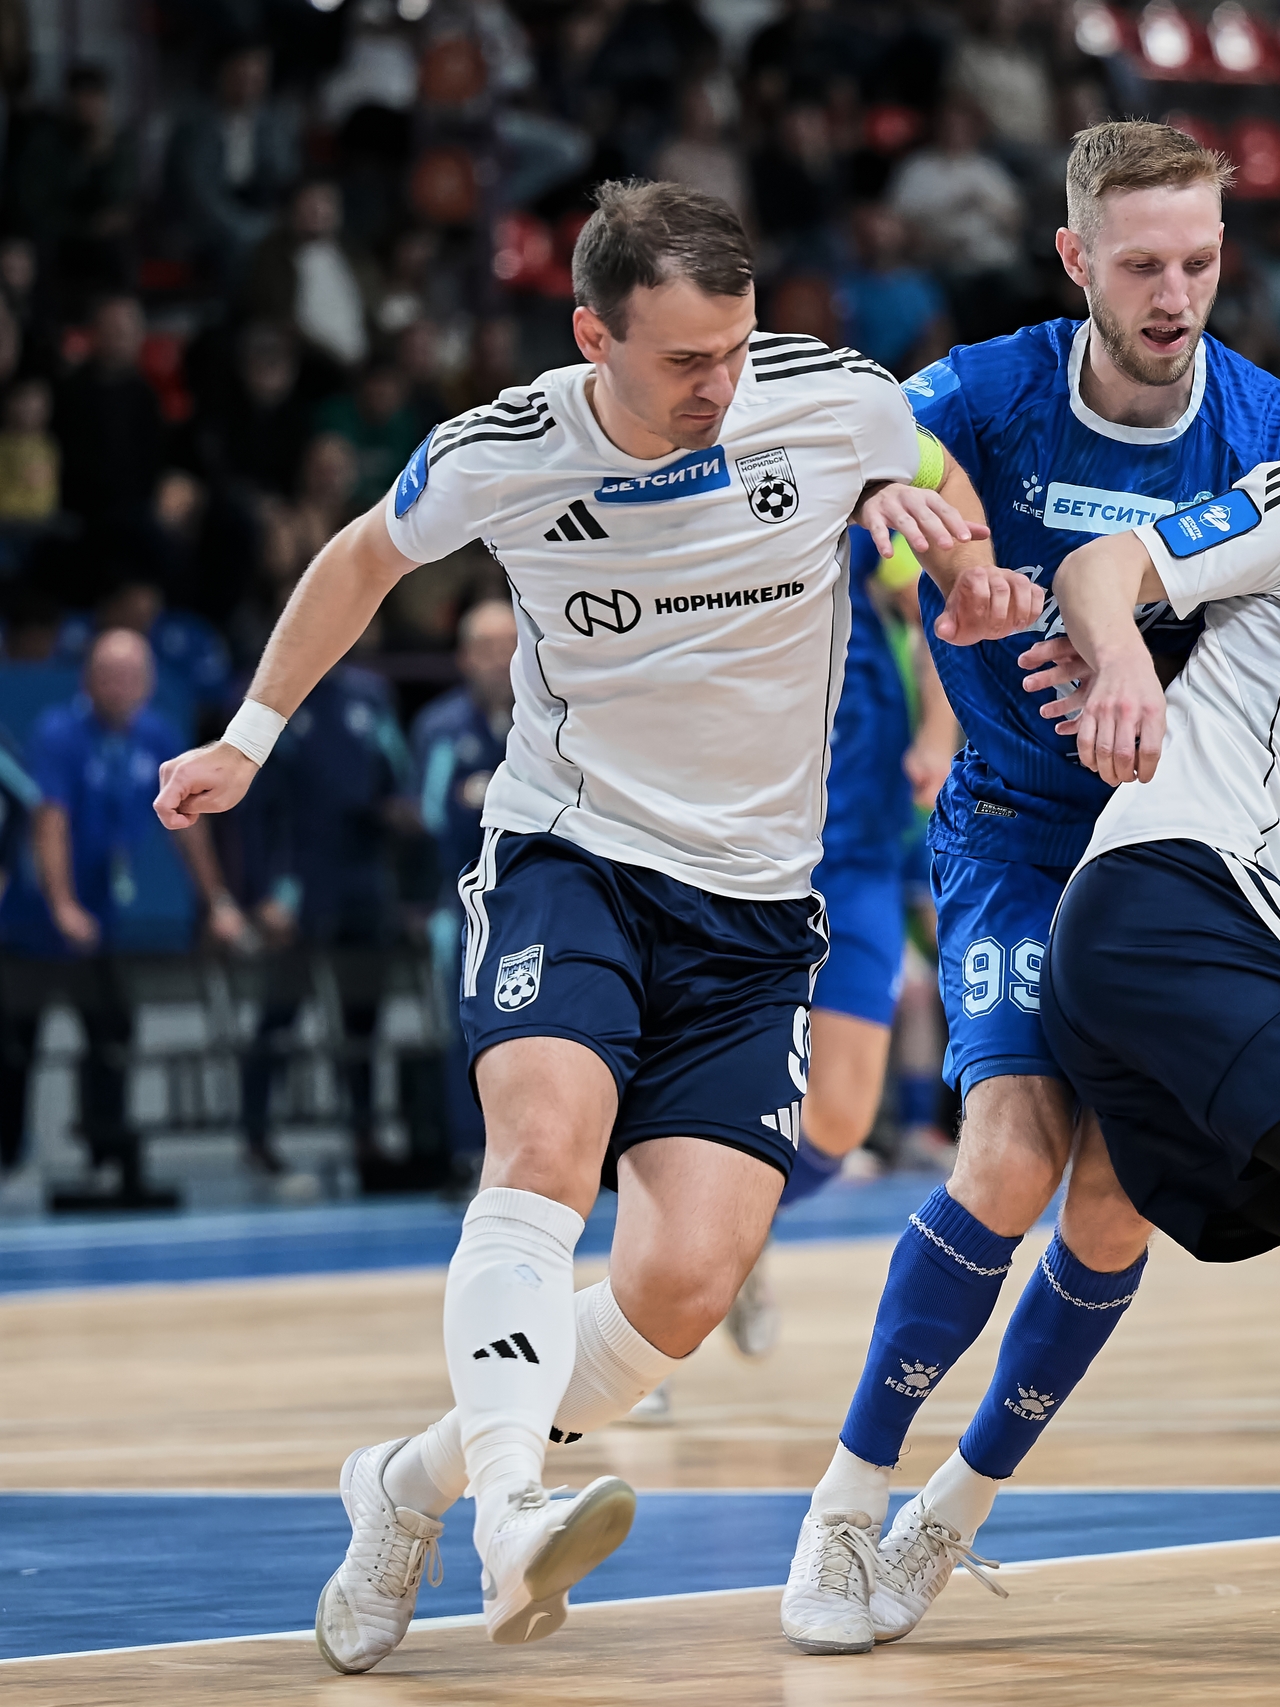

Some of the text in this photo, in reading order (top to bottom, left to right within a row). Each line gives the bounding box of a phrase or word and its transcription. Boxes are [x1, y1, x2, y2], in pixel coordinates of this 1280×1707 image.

[741, 456, 784, 472] НОРИЛЬСК
[654, 581, 805, 614] НОРНИКЕЛЬ
[961, 935, 1046, 1020] 99
[884, 1376, 932, 1398] KELME
[1003, 1397, 1049, 1421] KELME
